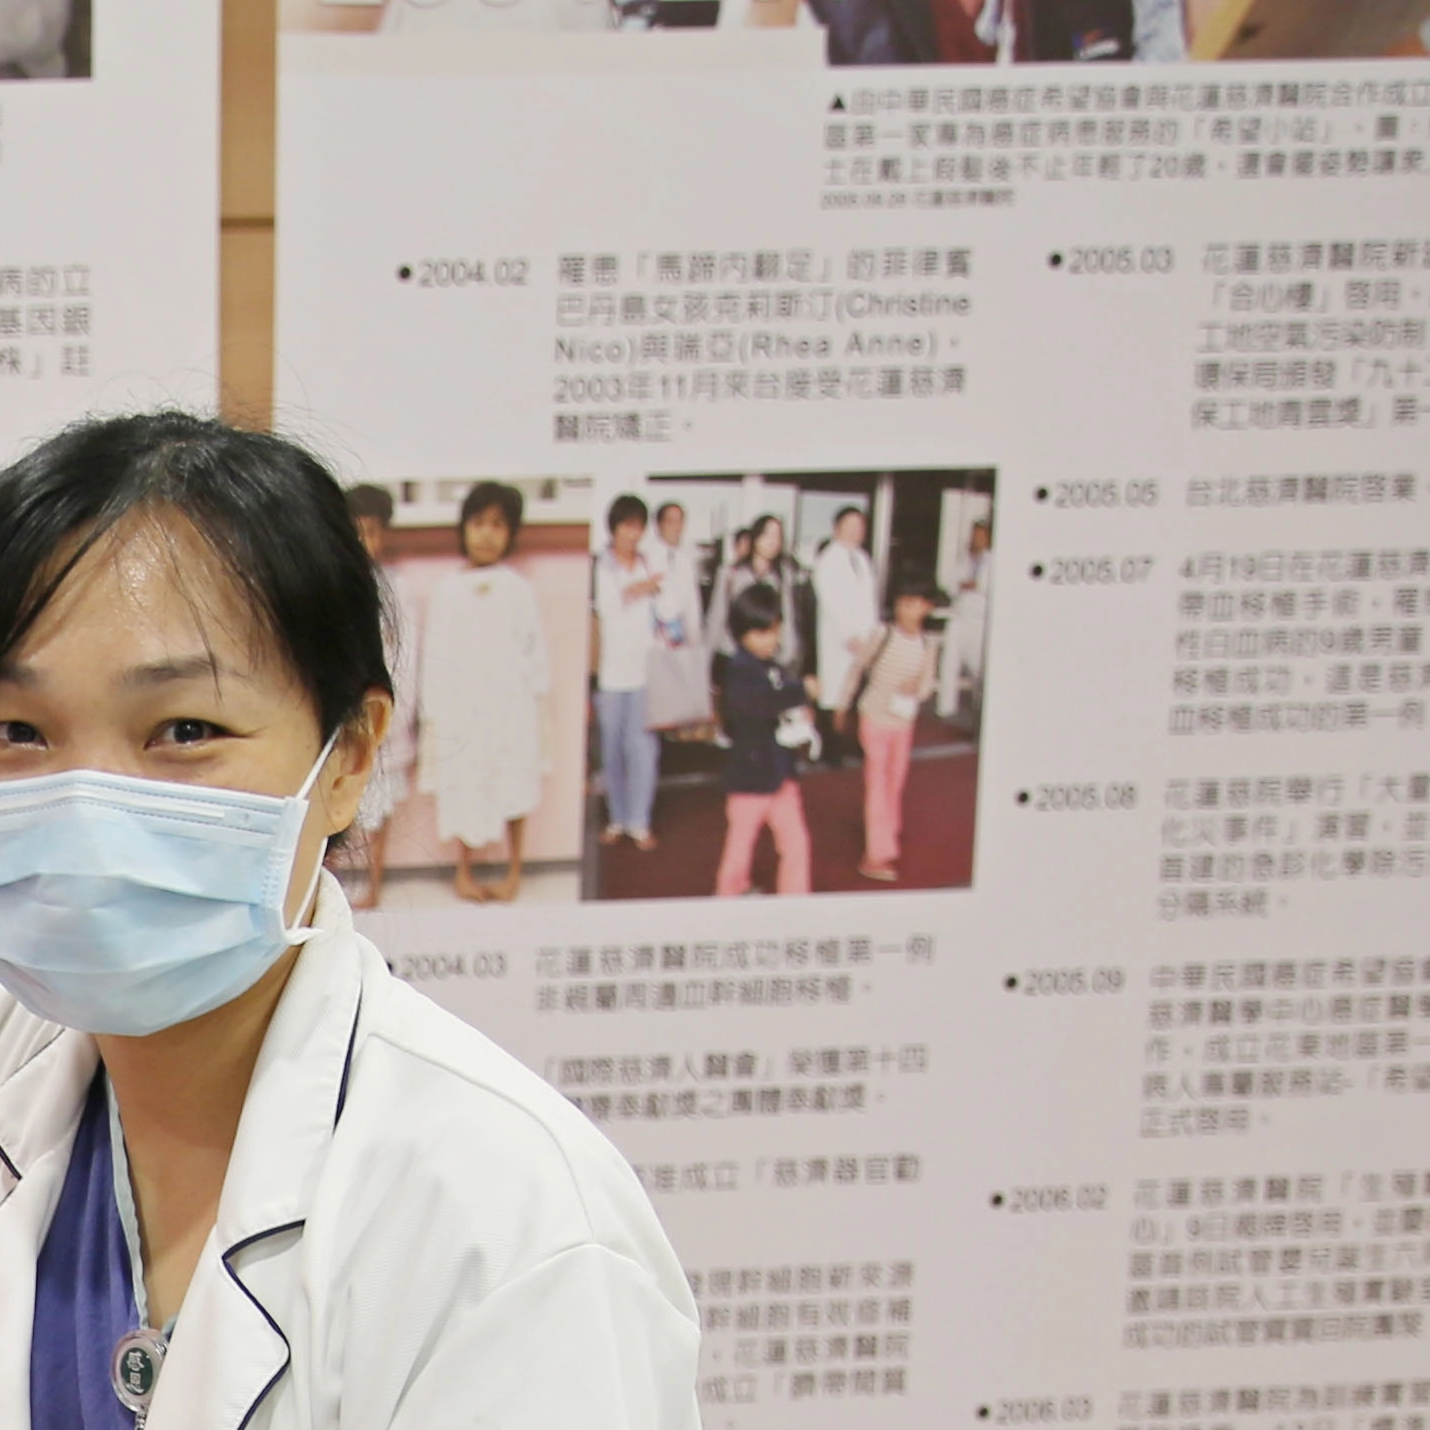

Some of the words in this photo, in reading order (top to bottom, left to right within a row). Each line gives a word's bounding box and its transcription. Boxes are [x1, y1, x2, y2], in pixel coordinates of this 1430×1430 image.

[419, 260, 530, 287] 2004.02
[1196, 357, 1430, 391] 環保局頒發「九十
